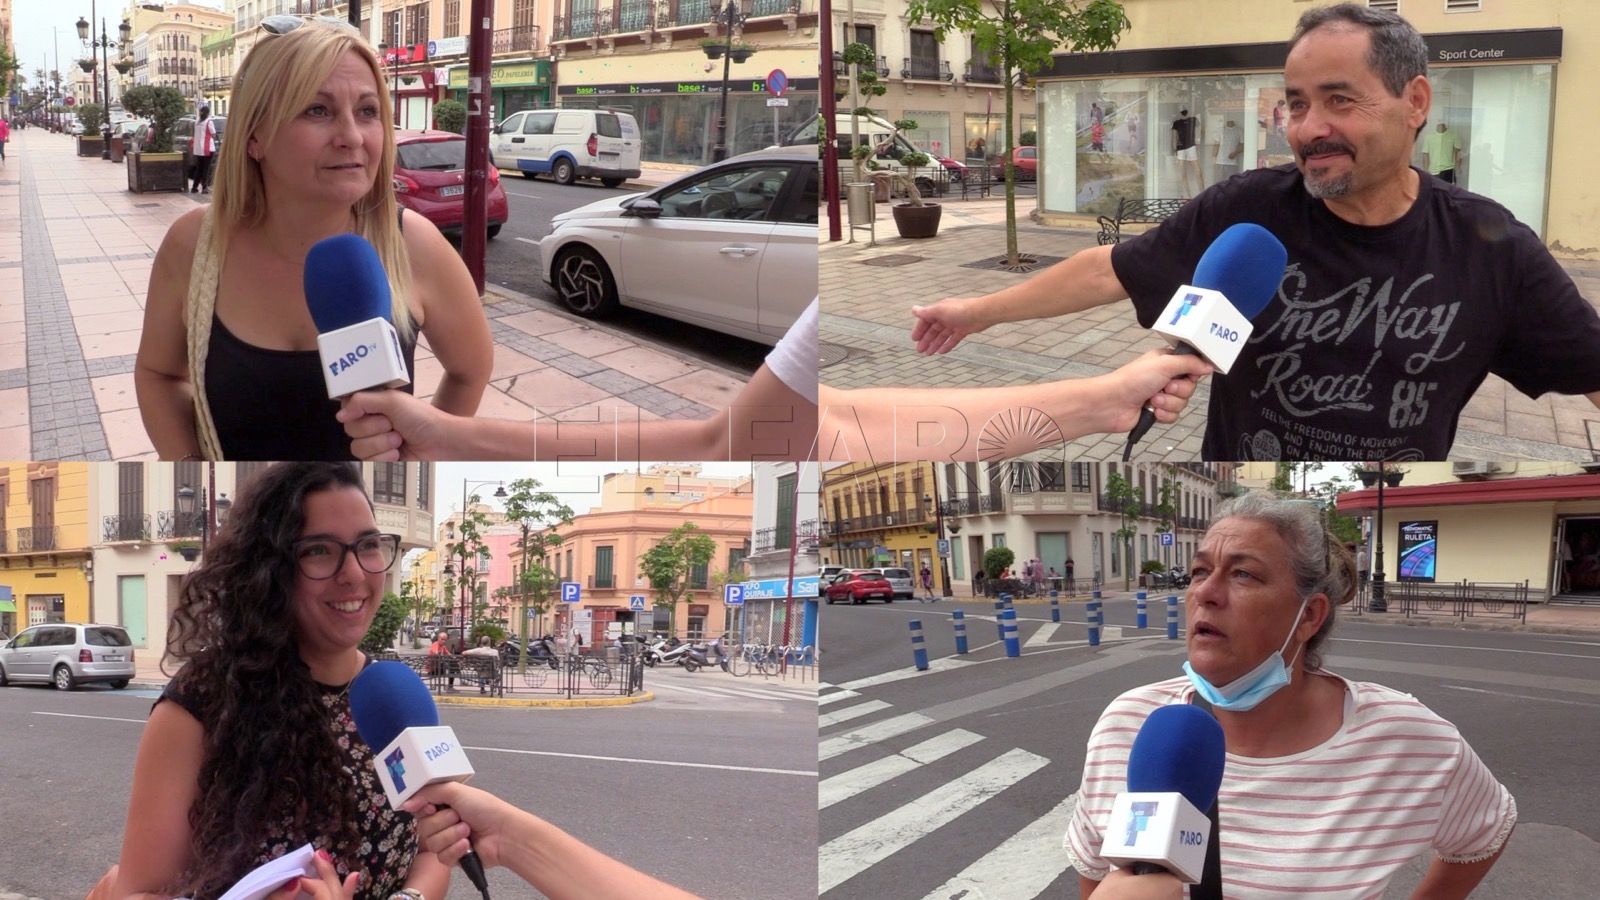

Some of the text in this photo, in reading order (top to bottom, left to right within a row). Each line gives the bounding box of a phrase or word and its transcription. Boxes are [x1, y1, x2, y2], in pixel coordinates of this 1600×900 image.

[1439, 48, 1505, 61] Sport Center
[1335, 274, 1465, 374] Way
[329, 344, 369, 377] FARO
[1251, 343, 1438, 428] Road 85
[1284, 431, 1303, 446] AND
[1309, 440, 1344, 456] ENJOY
[1346, 447, 1364, 459] THE
[1294, 422, 1342, 444] FREEDOM
[1344, 434, 1358, 446] OF
[1360, 436, 1409, 448] MOVEMENT
[1286, 445, 1300, 458] ON
[744, 582, 760, 590] XPO
[744, 589, 774, 598] QUIPAJE
[1180, 830, 1203, 846] FARO
